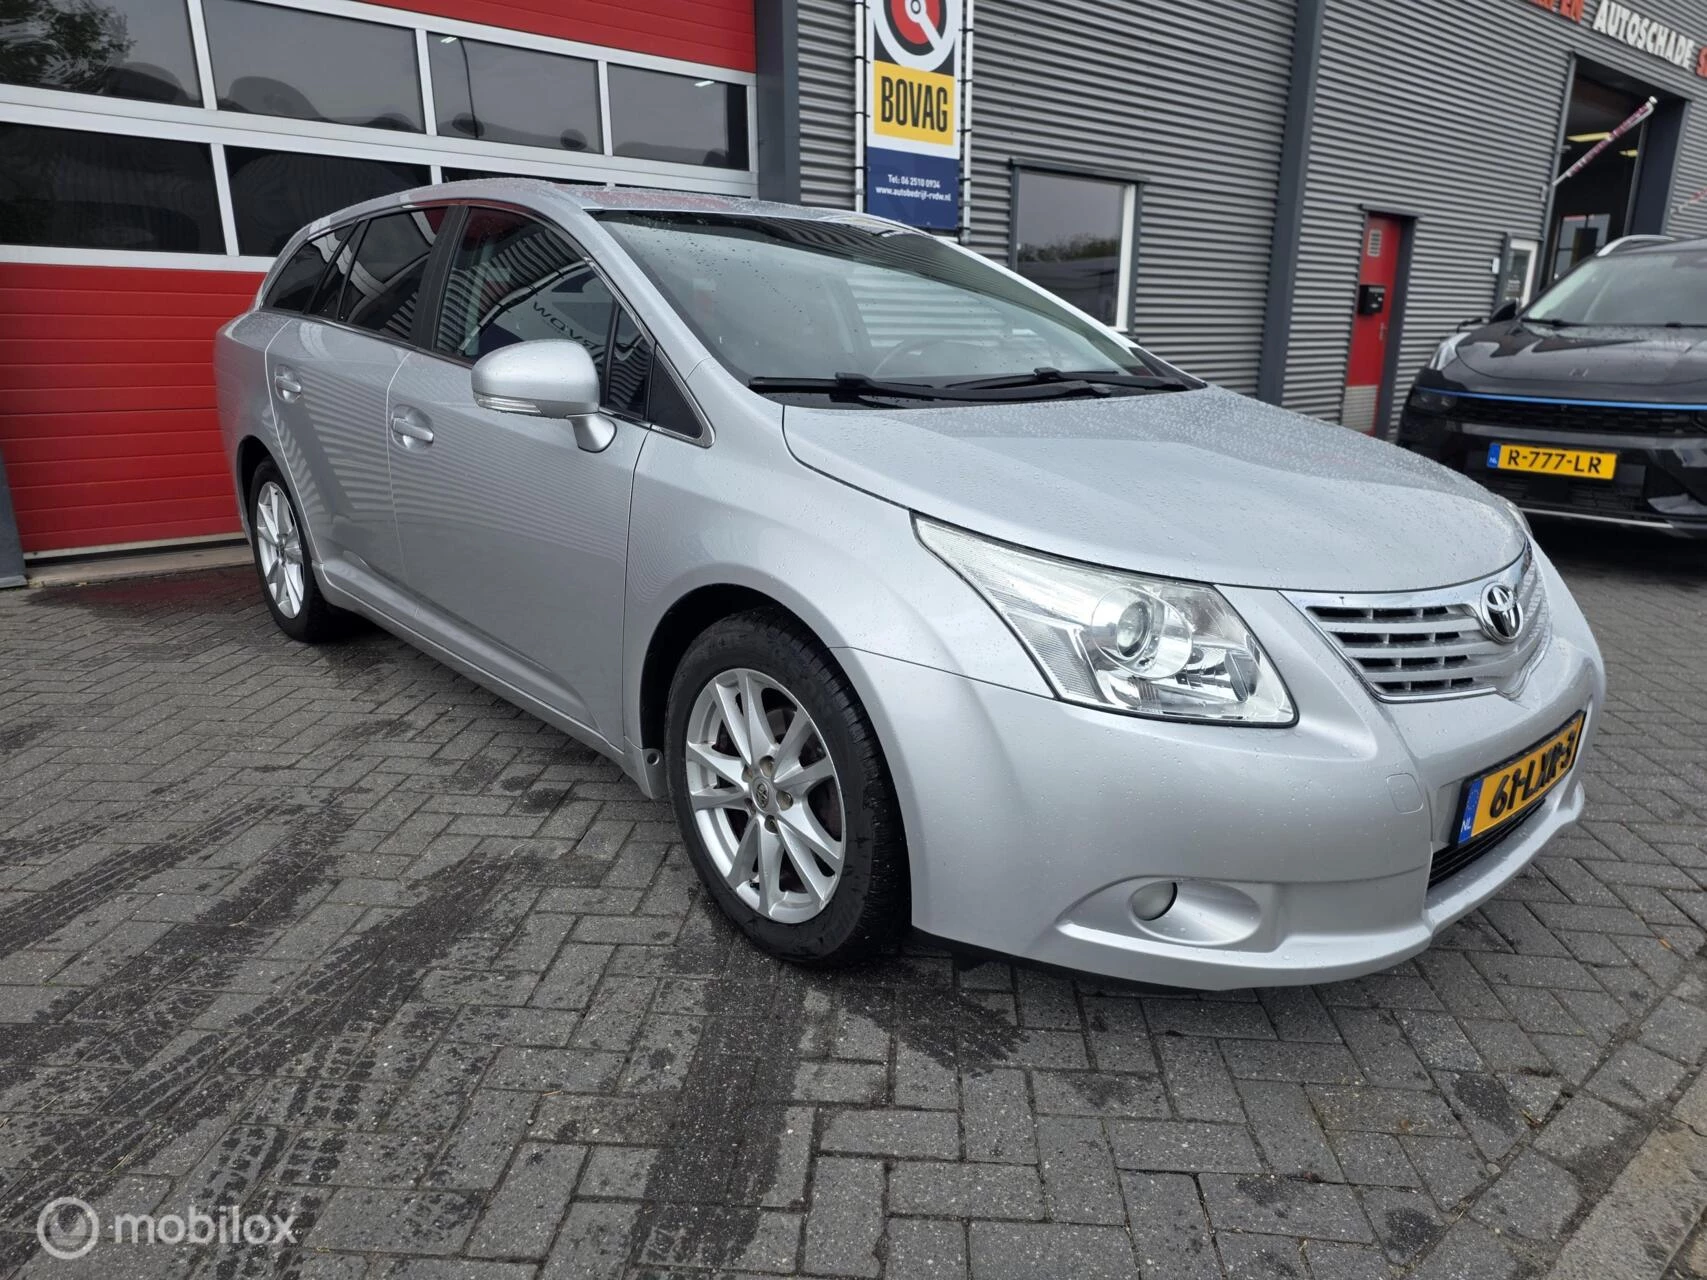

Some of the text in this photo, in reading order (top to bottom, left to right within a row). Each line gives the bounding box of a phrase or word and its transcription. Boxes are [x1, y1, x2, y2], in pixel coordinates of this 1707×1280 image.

[1593, 0, 1695, 70] AUTOSCHADE
[881, 76, 948, 133] BOVAG
[901, 176, 909, 185] 06
[1507, 449, 1602, 474] R-777-LR
[1461, 819, 1472, 833] NL
